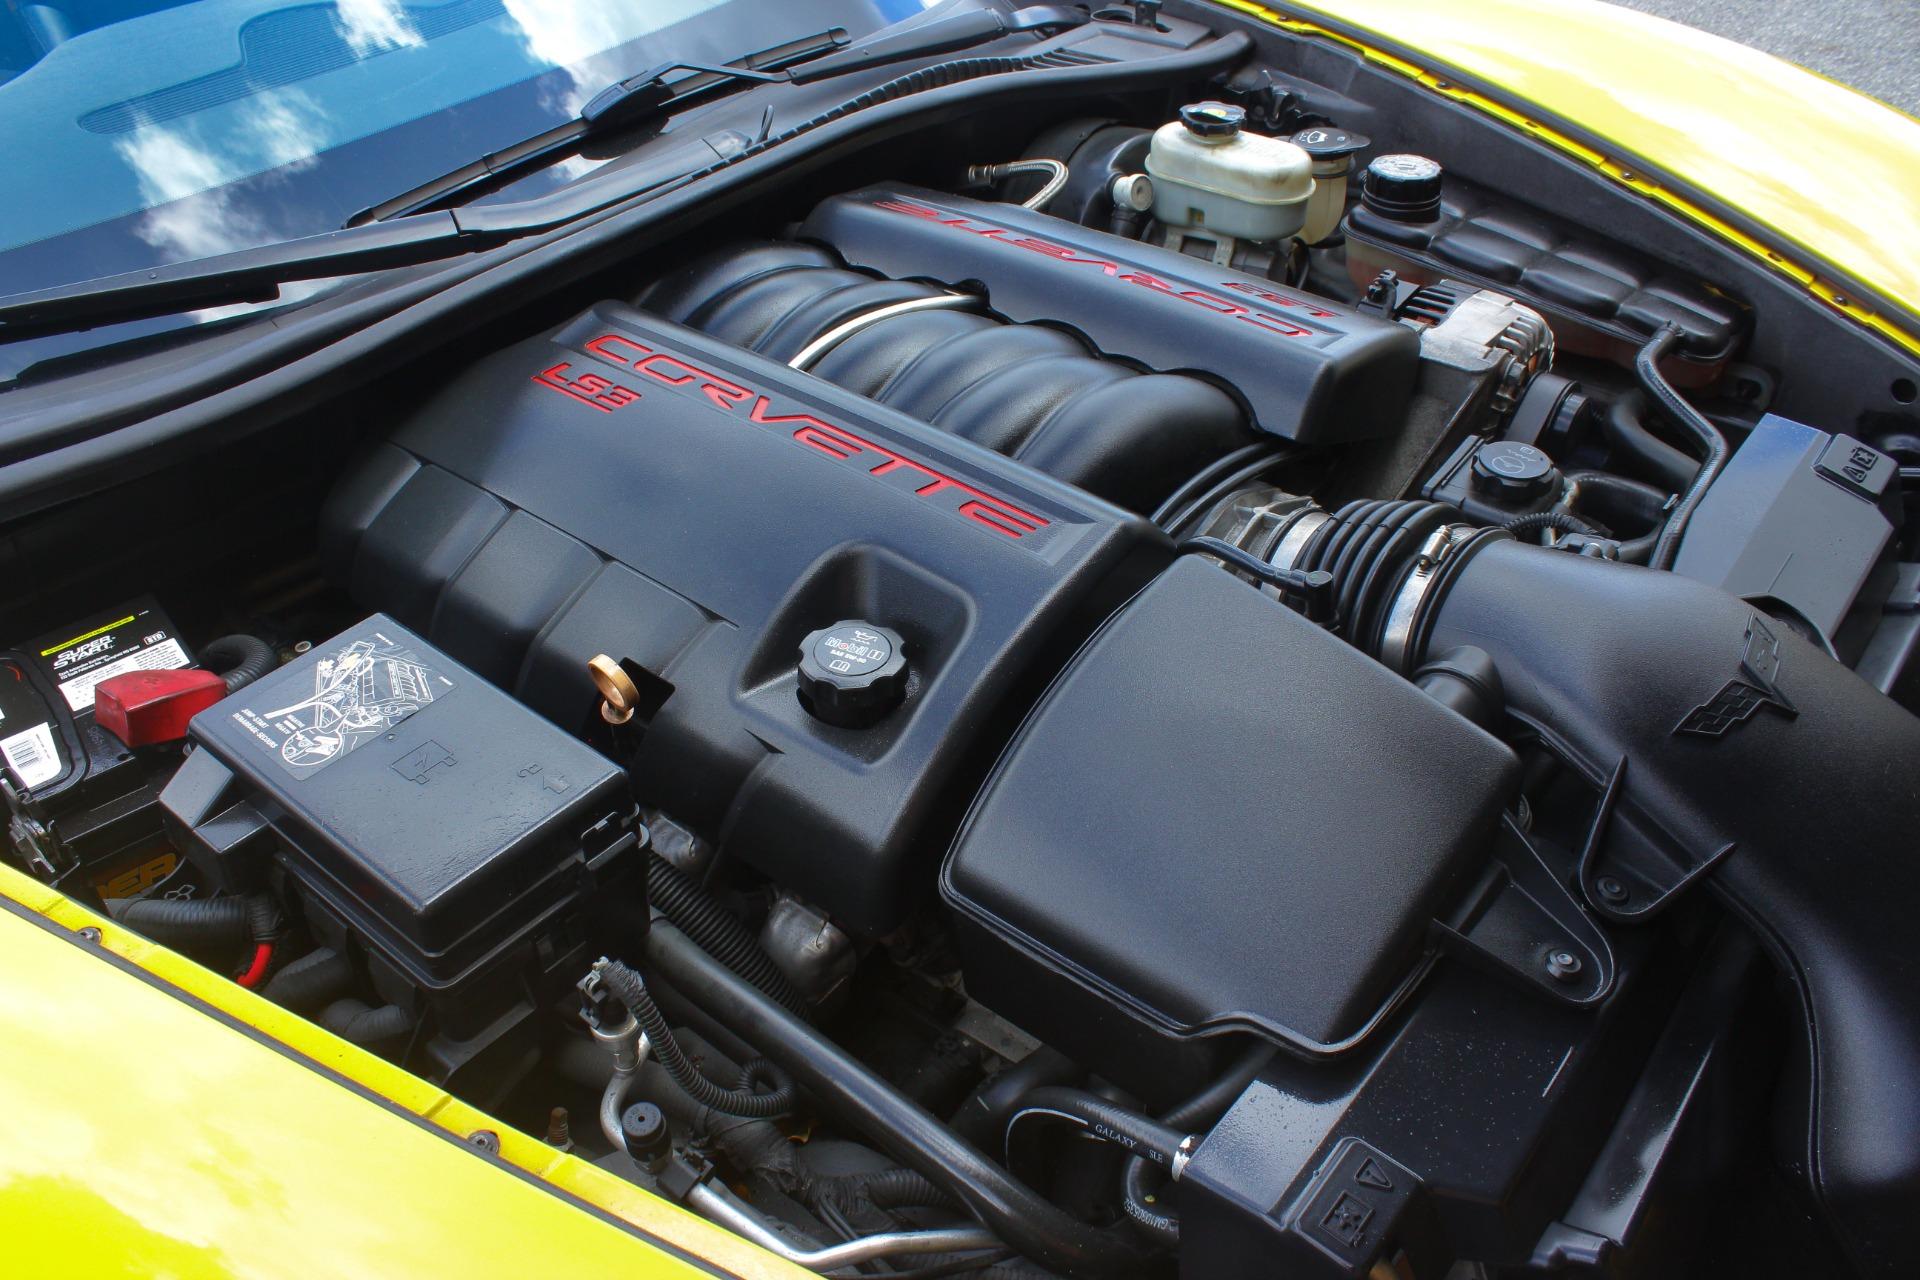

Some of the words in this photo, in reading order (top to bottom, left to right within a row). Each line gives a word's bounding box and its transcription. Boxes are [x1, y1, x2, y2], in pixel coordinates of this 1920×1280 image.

[872, 201, 1313, 336] CORVETTE
[1220, 282, 1343, 317] LS3
[532, 362, 642, 413] LS3
[584, 334, 1050, 539] CORVETTE
[54, 642, 114, 669] START
[57, 635, 111, 660] SUPER
[825, 637, 868, 656] Mobil
[1095, 1124, 1137, 1149] GALAXY
